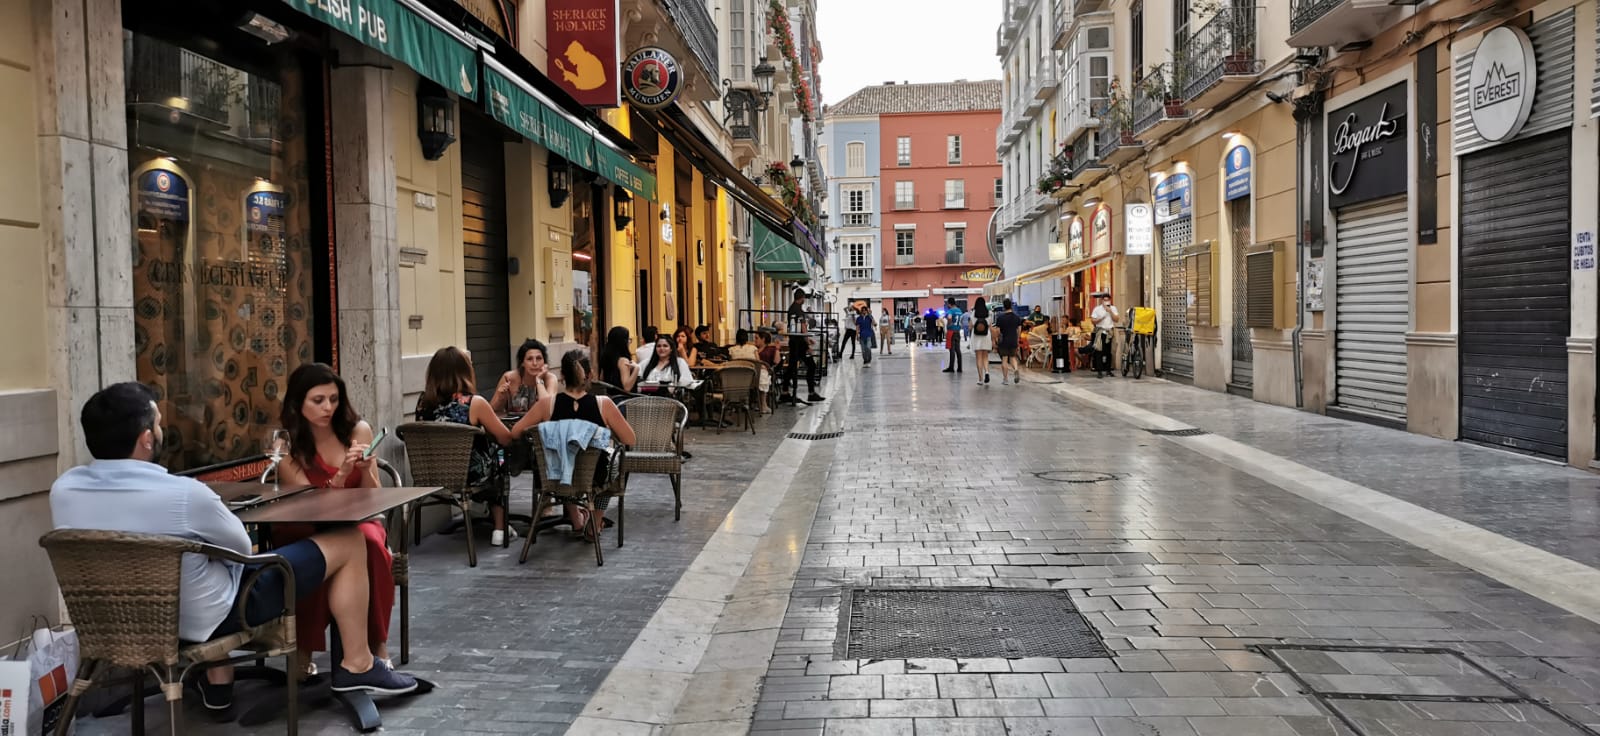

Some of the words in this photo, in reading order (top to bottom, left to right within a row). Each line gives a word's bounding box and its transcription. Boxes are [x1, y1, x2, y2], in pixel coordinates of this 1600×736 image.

[305, 0, 352, 24] LISH
[358, 6, 388, 43] PUB
[552, 7, 607, 20] SHERLOCK
[555, 20, 607, 31] HOLMES
[626, 50, 676, 74] PAULANER
[1477, 79, 1518, 105] EVEREST
